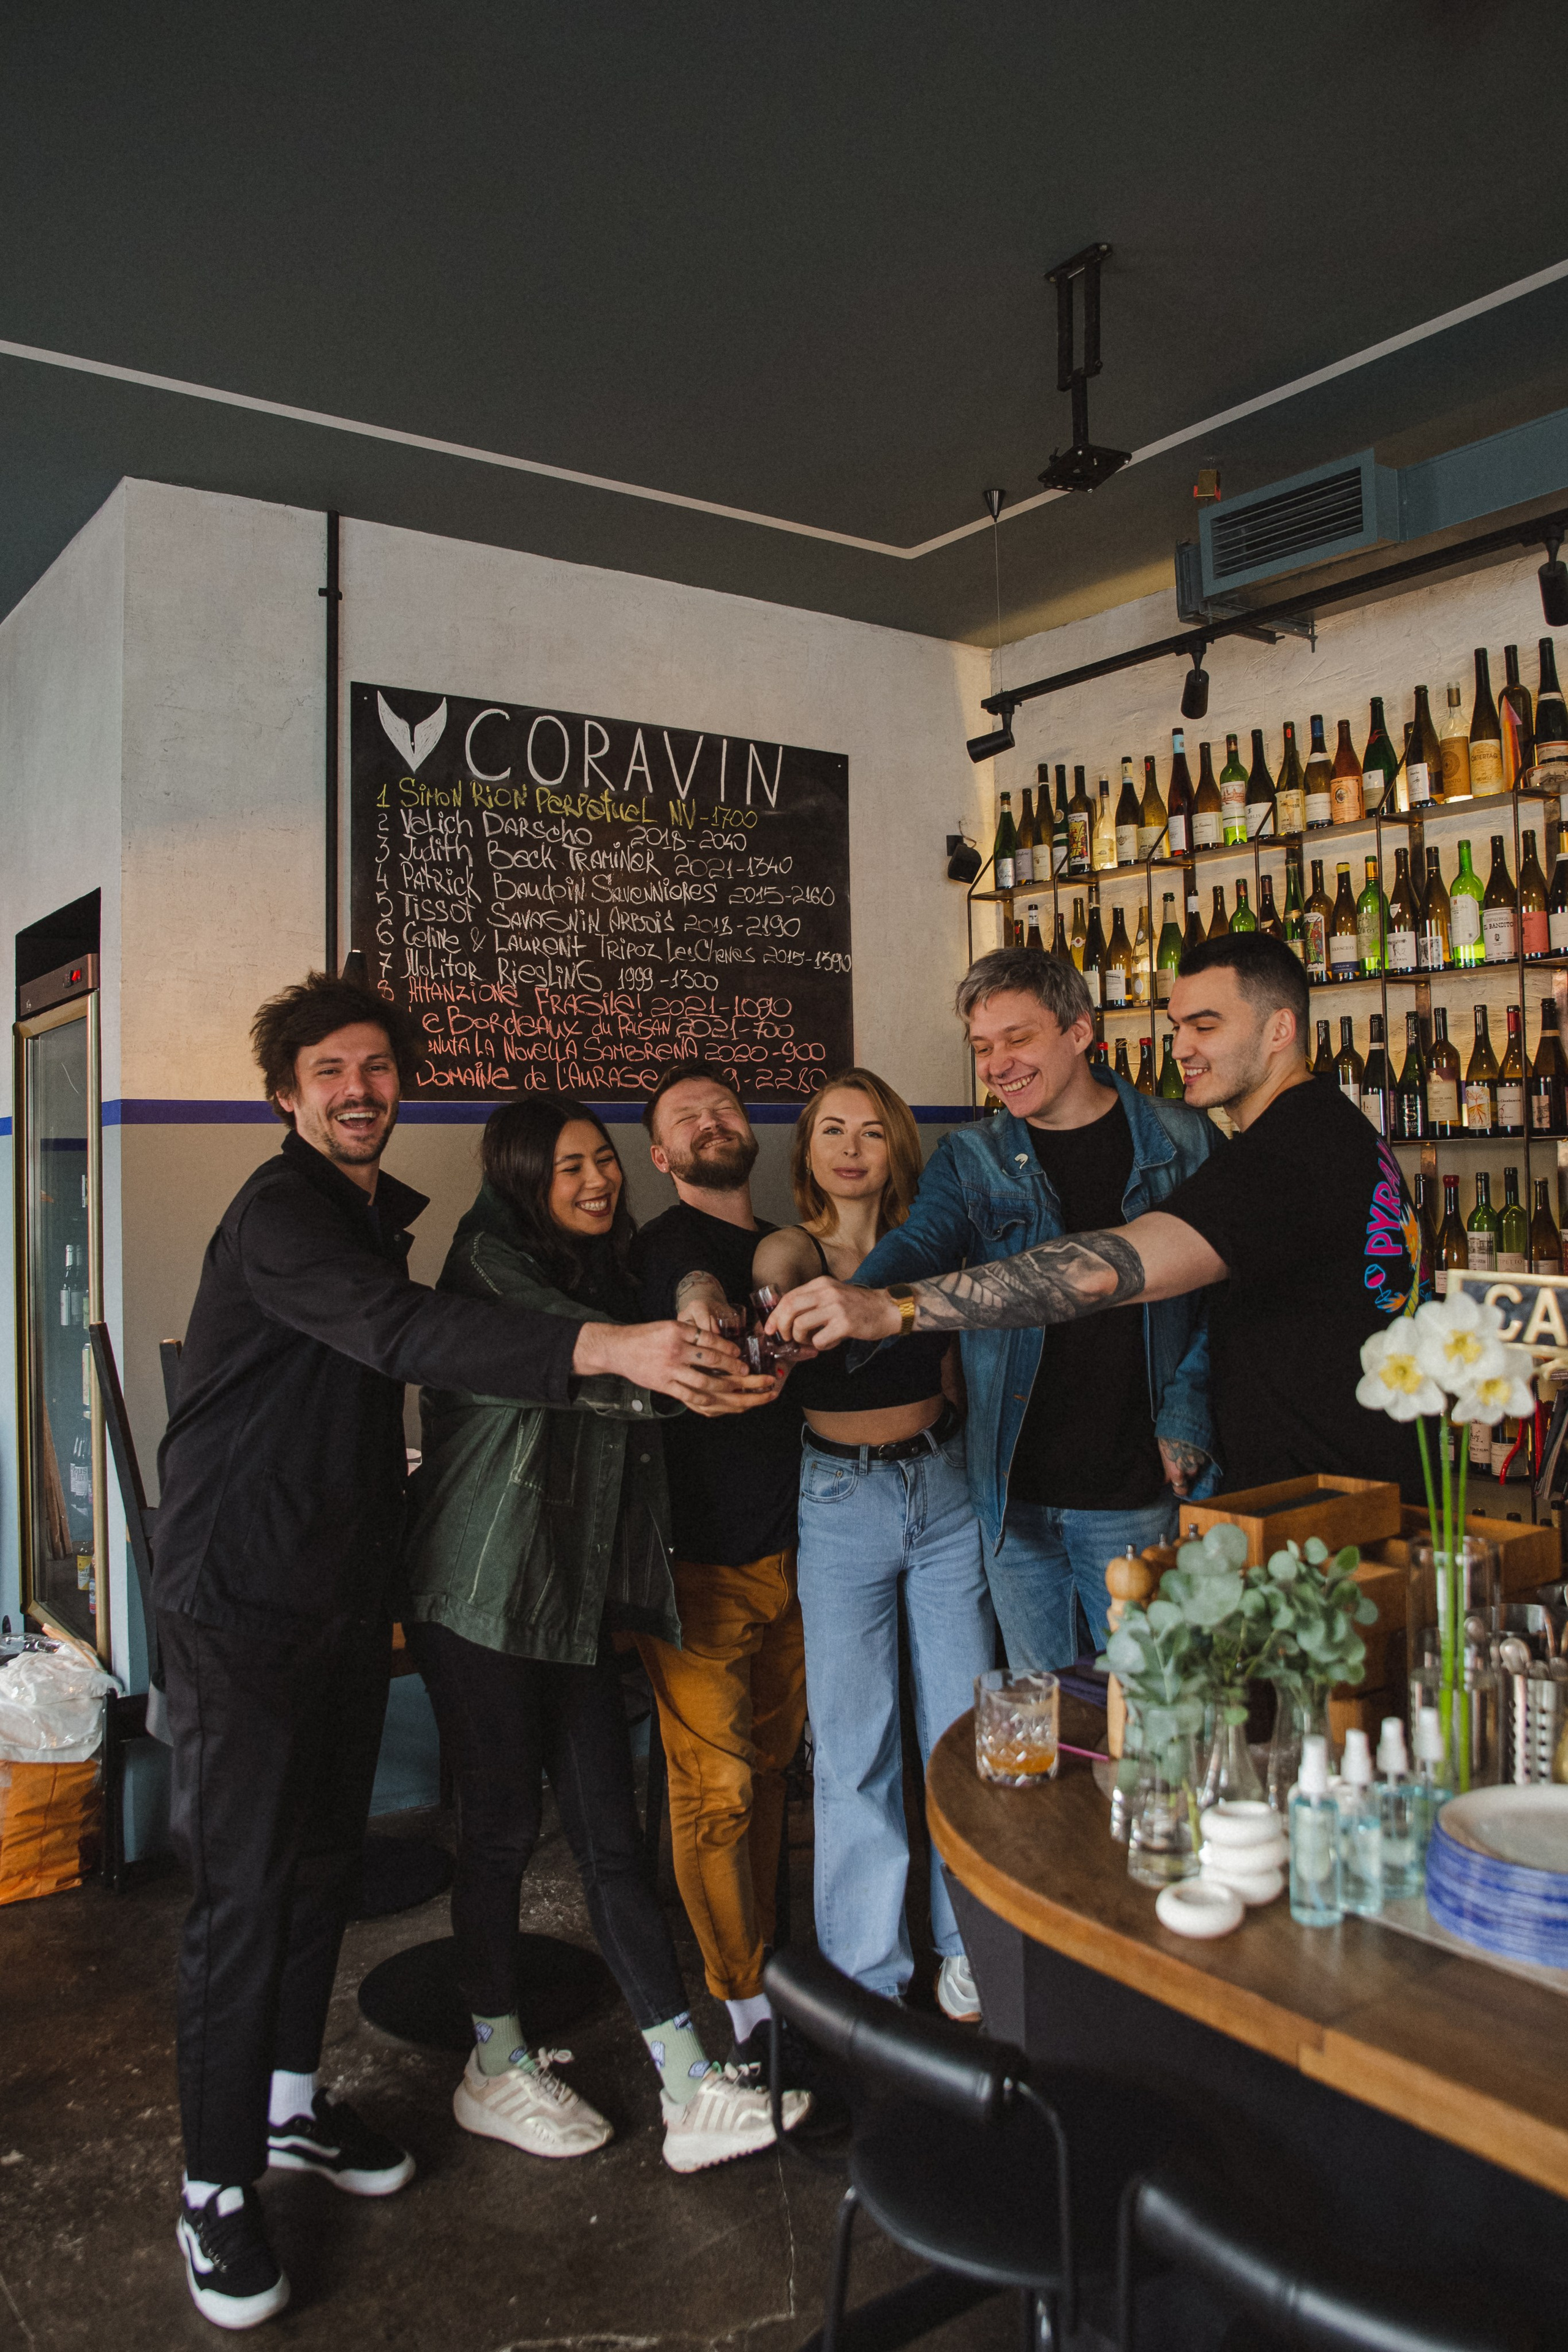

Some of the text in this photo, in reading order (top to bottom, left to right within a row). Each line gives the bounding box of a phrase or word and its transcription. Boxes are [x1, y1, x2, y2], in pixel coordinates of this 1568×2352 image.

[466, 709, 783, 807] CORAVIN
[377, 784, 390, 807] 1
[378, 813, 389, 831] 2
[375, 834, 390, 862] 3
[377, 864, 388, 889] 4
[376, 891, 393, 918] 5
[376, 918, 394, 944] 6
[470, 927, 486, 952] &
[379, 951, 392, 978] 7
[377, 980, 394, 1001] 8
[592, 1016, 613, 1036] du
[524, 1065, 550, 1090] de
